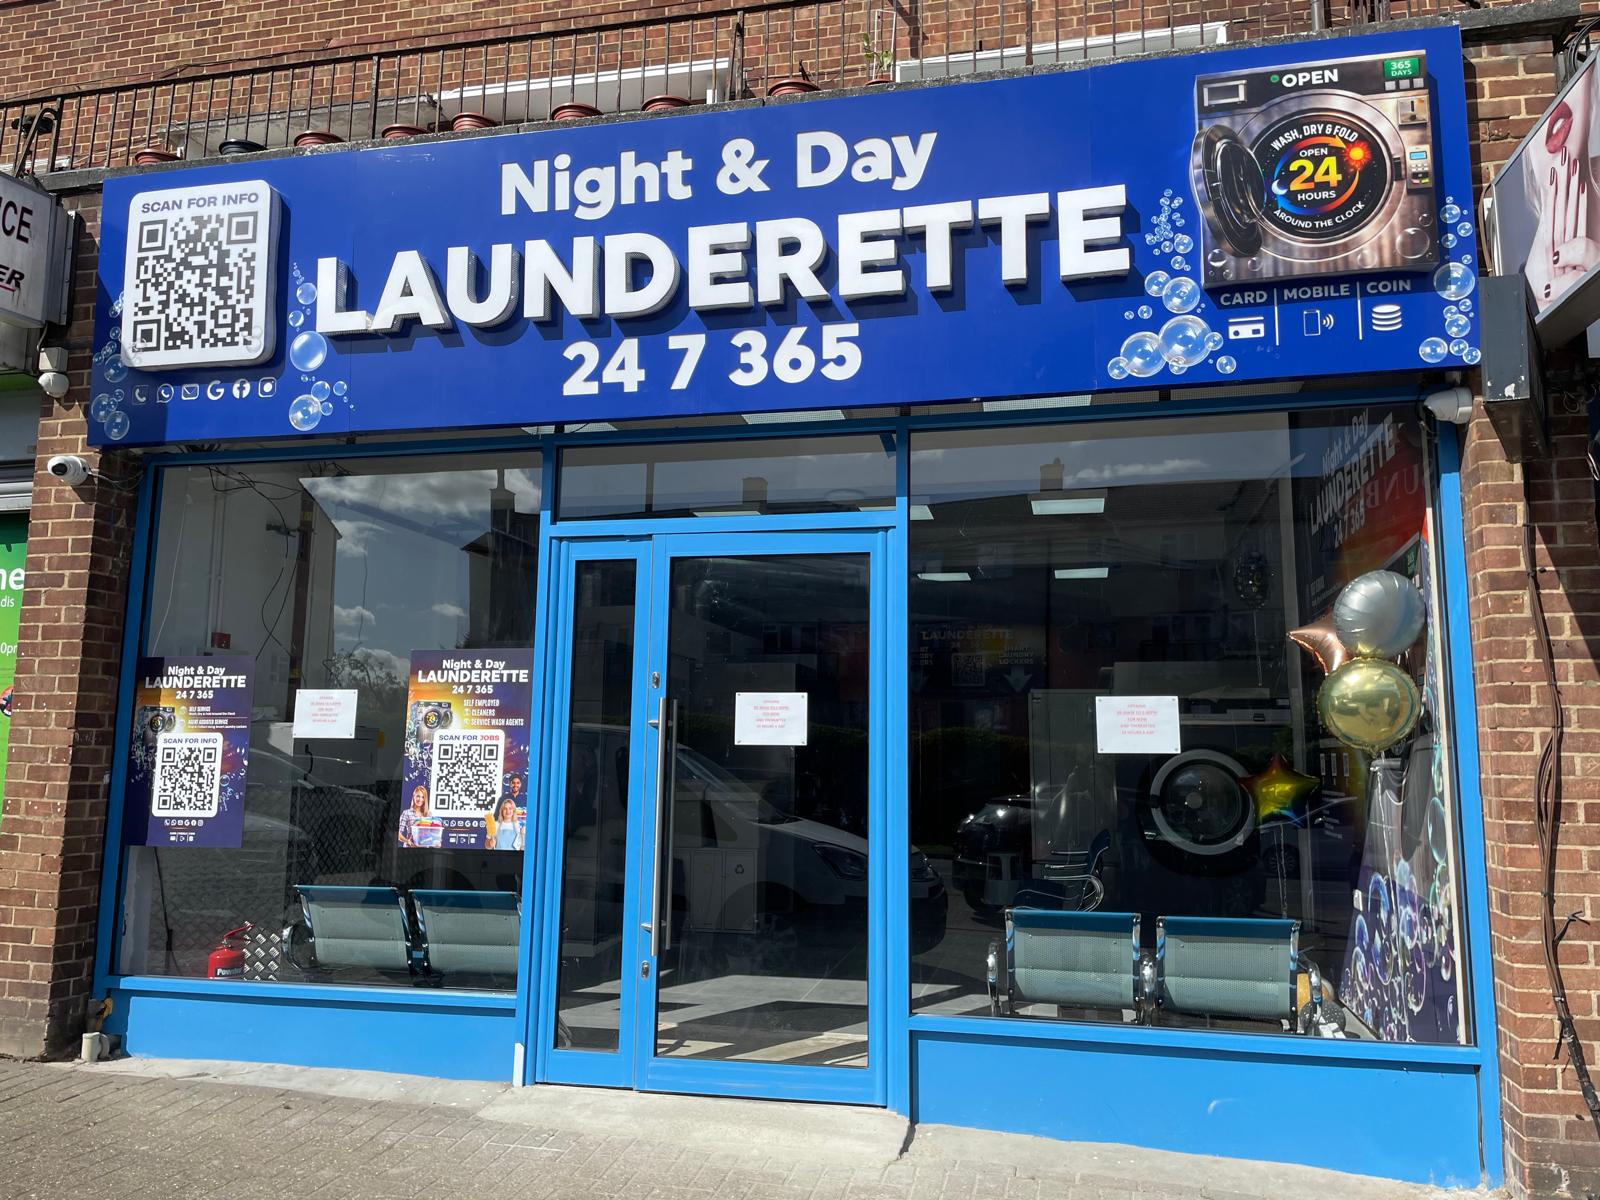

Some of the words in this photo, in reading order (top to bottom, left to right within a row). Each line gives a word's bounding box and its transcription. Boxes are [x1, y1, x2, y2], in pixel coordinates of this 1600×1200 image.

[1390, 60, 1412, 70] 365
[1391, 69, 1413, 77] DAYS
[1281, 68, 1339, 88] OPEN
[1270, 128, 1304, 152] WASH,
[1303, 123, 1324, 136] DRY
[1325, 124, 1332, 134] &
[1333, 125, 1359, 143] FOLD
[1299, 147, 1328, 158] OPEN
[500, 149, 693, 220] Night
[716, 137, 770, 195] &
[796, 130, 938, 191] Day
[1289, 156, 1342, 191] 24
[141, 199, 183, 214] SCAN
[187, 196, 218, 209] FOR
[222, 192, 259, 206] INFO
[1297, 190, 1337, 201] HOURS
[0, 197, 33, 243] CE
[1273, 208, 1312, 230] AROUND
[1314, 218, 1334, 229] THE
[1336, 201, 1366, 224] CLOCK
[315, 184, 1132, 336] LAUNDERETTE
[1220, 290, 1268, 306] CARD
[1283, 284, 1350, 300] MOBILE
[1366, 279, 1411, 294] COIN
[562, 337, 645, 397] 24
[668, 333, 706, 390] 7
[728, 322, 862, 387] 365
[1322, 437, 1343, 480] Night
[1344, 427, 1351, 455] &
[1352, 407, 1369, 445] Day
[1310, 411, 1396, 536] LAUNDERETTE
[1334, 520, 1343, 550] 24
[1350, 499, 1366, 535] 365
[167, 665, 195, 676] Night
[196, 665, 205, 675] &
[207, 665, 226, 676] Day
[442, 659, 472, 670] Night
[474, 660, 482, 669] &
[485, 659, 506, 670] Day
[145, 675, 247, 689] LAUNDERETTE
[417, 669, 529, 683] LAUNDERETTE
[175, 690, 187, 699] 24
[189, 690, 195, 699] 7
[196, 690, 214, 699] 365
[452, 685, 464, 694] 24
[467, 685, 473, 694] 7
[475, 685, 494, 694] 365
[463, 699, 475, 707] SELF
[474, 699, 500, 707] EMPLOYED
[471, 708, 496, 716] CLEANERS
[471, 718, 490, 726] SERVICE
[491, 718, 505, 726] WASH
[506, 718, 524, 726] AGENTS
